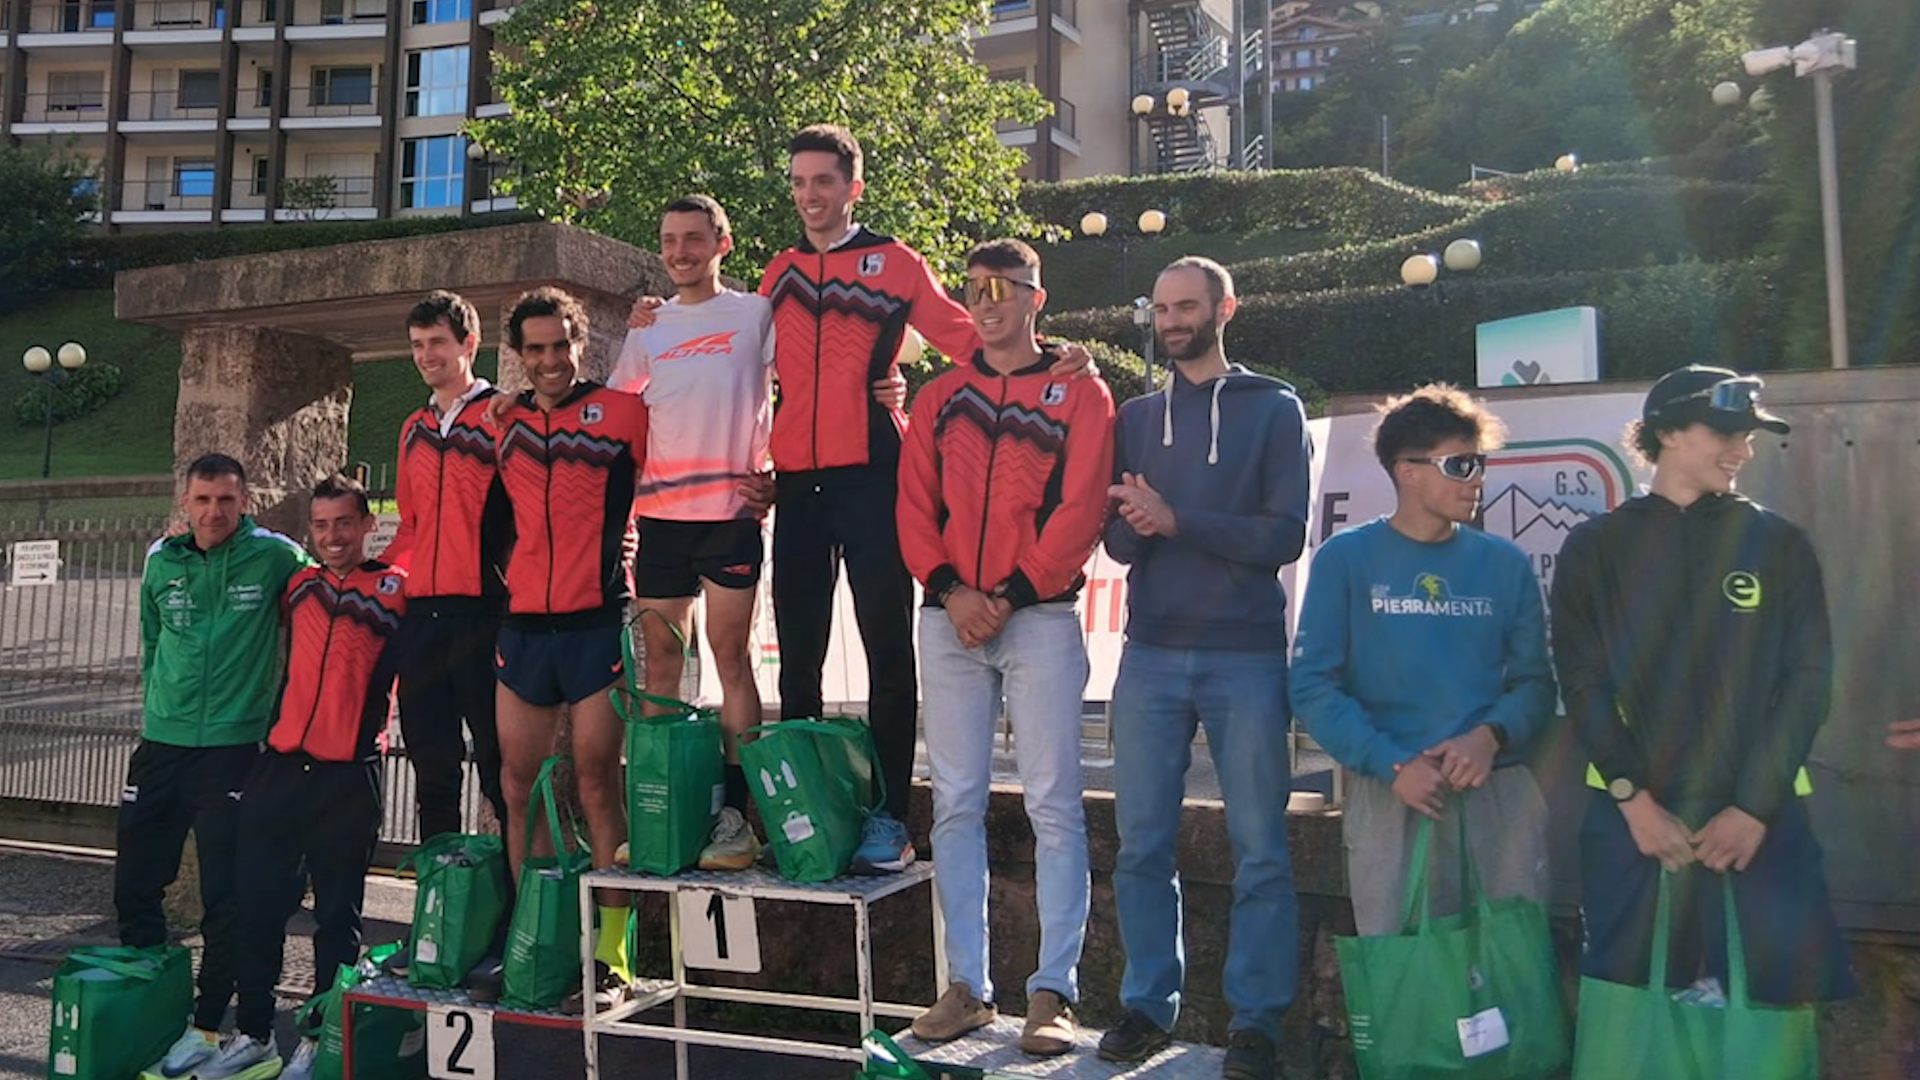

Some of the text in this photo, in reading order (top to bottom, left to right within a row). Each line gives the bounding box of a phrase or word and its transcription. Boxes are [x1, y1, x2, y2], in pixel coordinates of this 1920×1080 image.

[1556, 470, 1596, 496] G.S.
[706, 891, 729, 959] 1
[446, 1010, 475, 1075] 2
